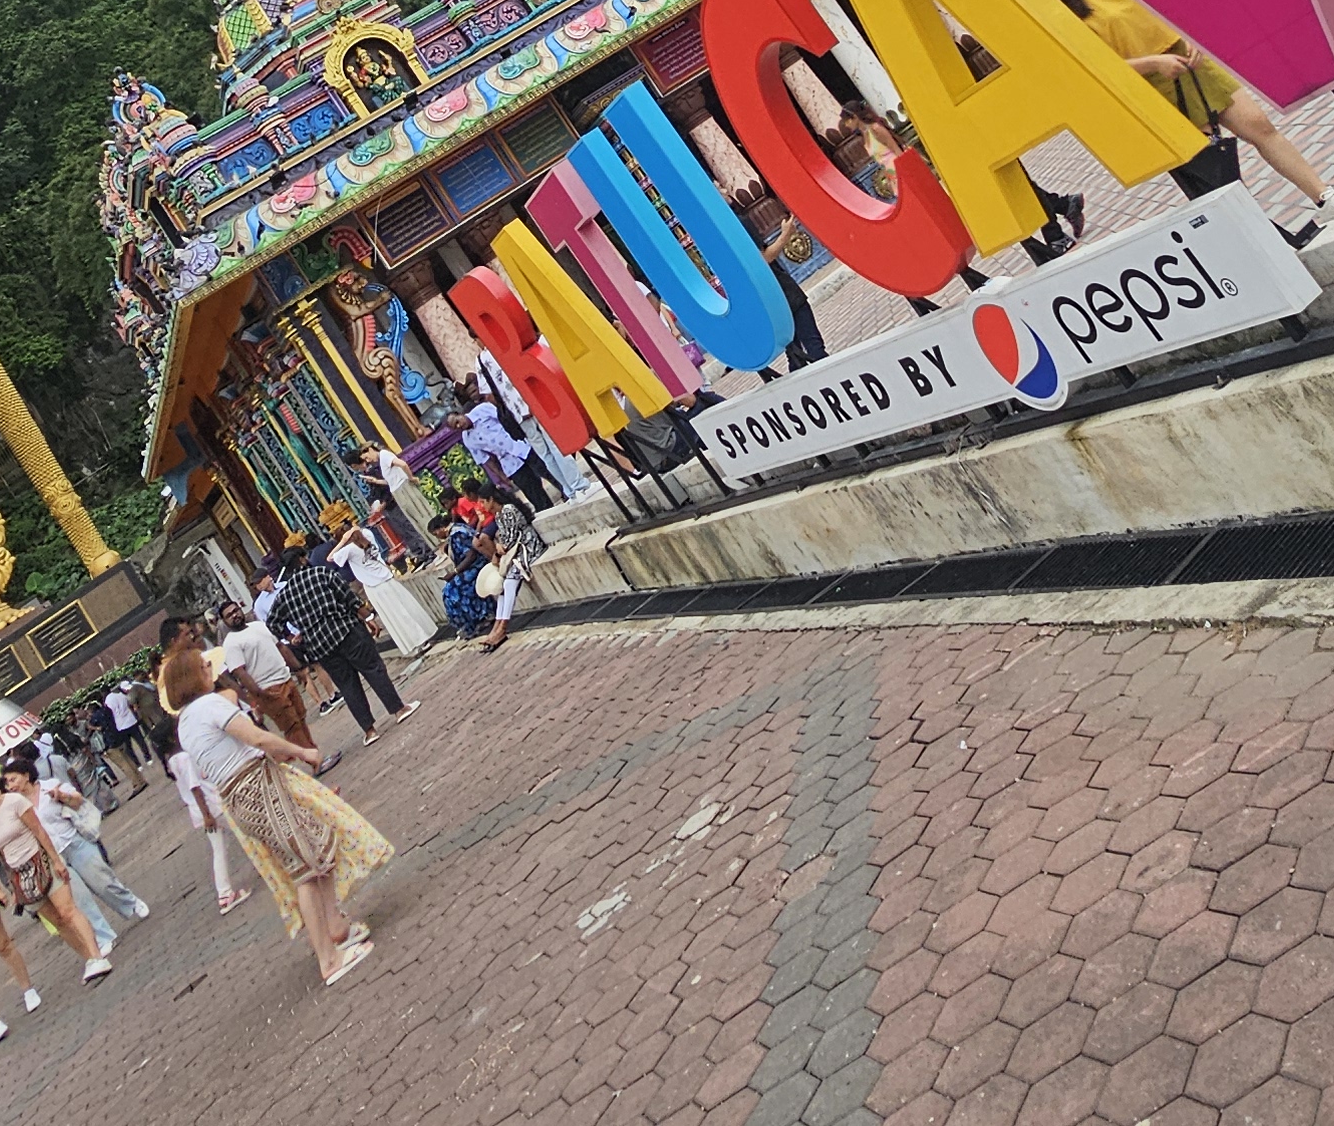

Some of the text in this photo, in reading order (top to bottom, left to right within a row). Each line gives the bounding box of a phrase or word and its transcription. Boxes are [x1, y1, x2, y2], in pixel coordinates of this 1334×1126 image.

[449, 80, 795, 454] BATU
[715, 229, 1226, 460] SPONSORED BY pepsi
